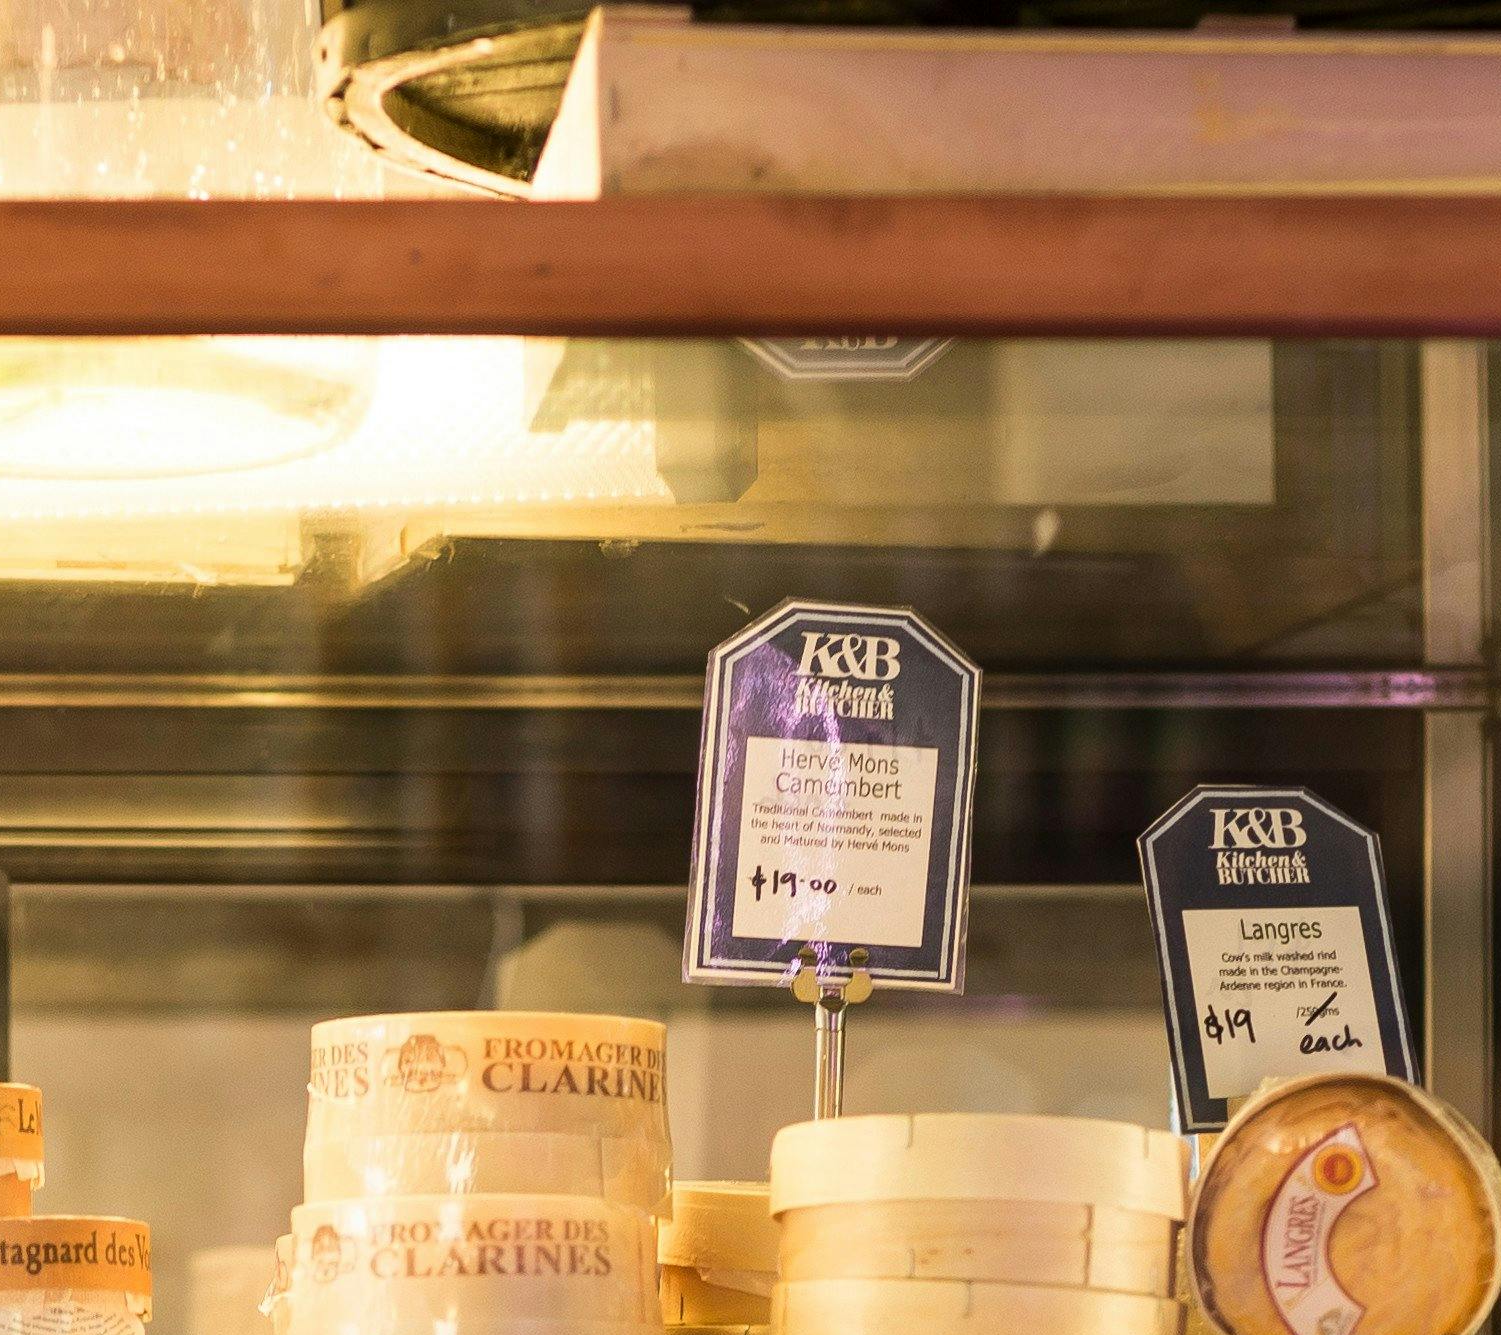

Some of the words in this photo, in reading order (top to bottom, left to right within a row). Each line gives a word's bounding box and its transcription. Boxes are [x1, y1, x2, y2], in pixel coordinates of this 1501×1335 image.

[797, 631, 901, 680] K&B
[848, 751, 900, 775] Mons
[775, 773, 903, 800] Camembert
[751, 819, 768, 830] the
[772, 820, 799, 832] heart
[802, 821, 814, 834] of
[879, 827, 922, 840] selected
[881, 812, 909, 823] made
[1208, 807, 1308, 851] K&B
[1216, 850, 1306, 869] Kitchen&
[1218, 867, 1311, 886] BUTCHER
[857, 884, 882, 896] each
[1240, 918, 1323, 944] Langres
[482, 1038, 643, 1065] FROMAGER
[1300, 1025, 1362, 1054] each
[564, 1220, 611, 1243] DES
[104, 1236, 135, 1267] des
[369, 1243, 613, 1277] CLARINES
